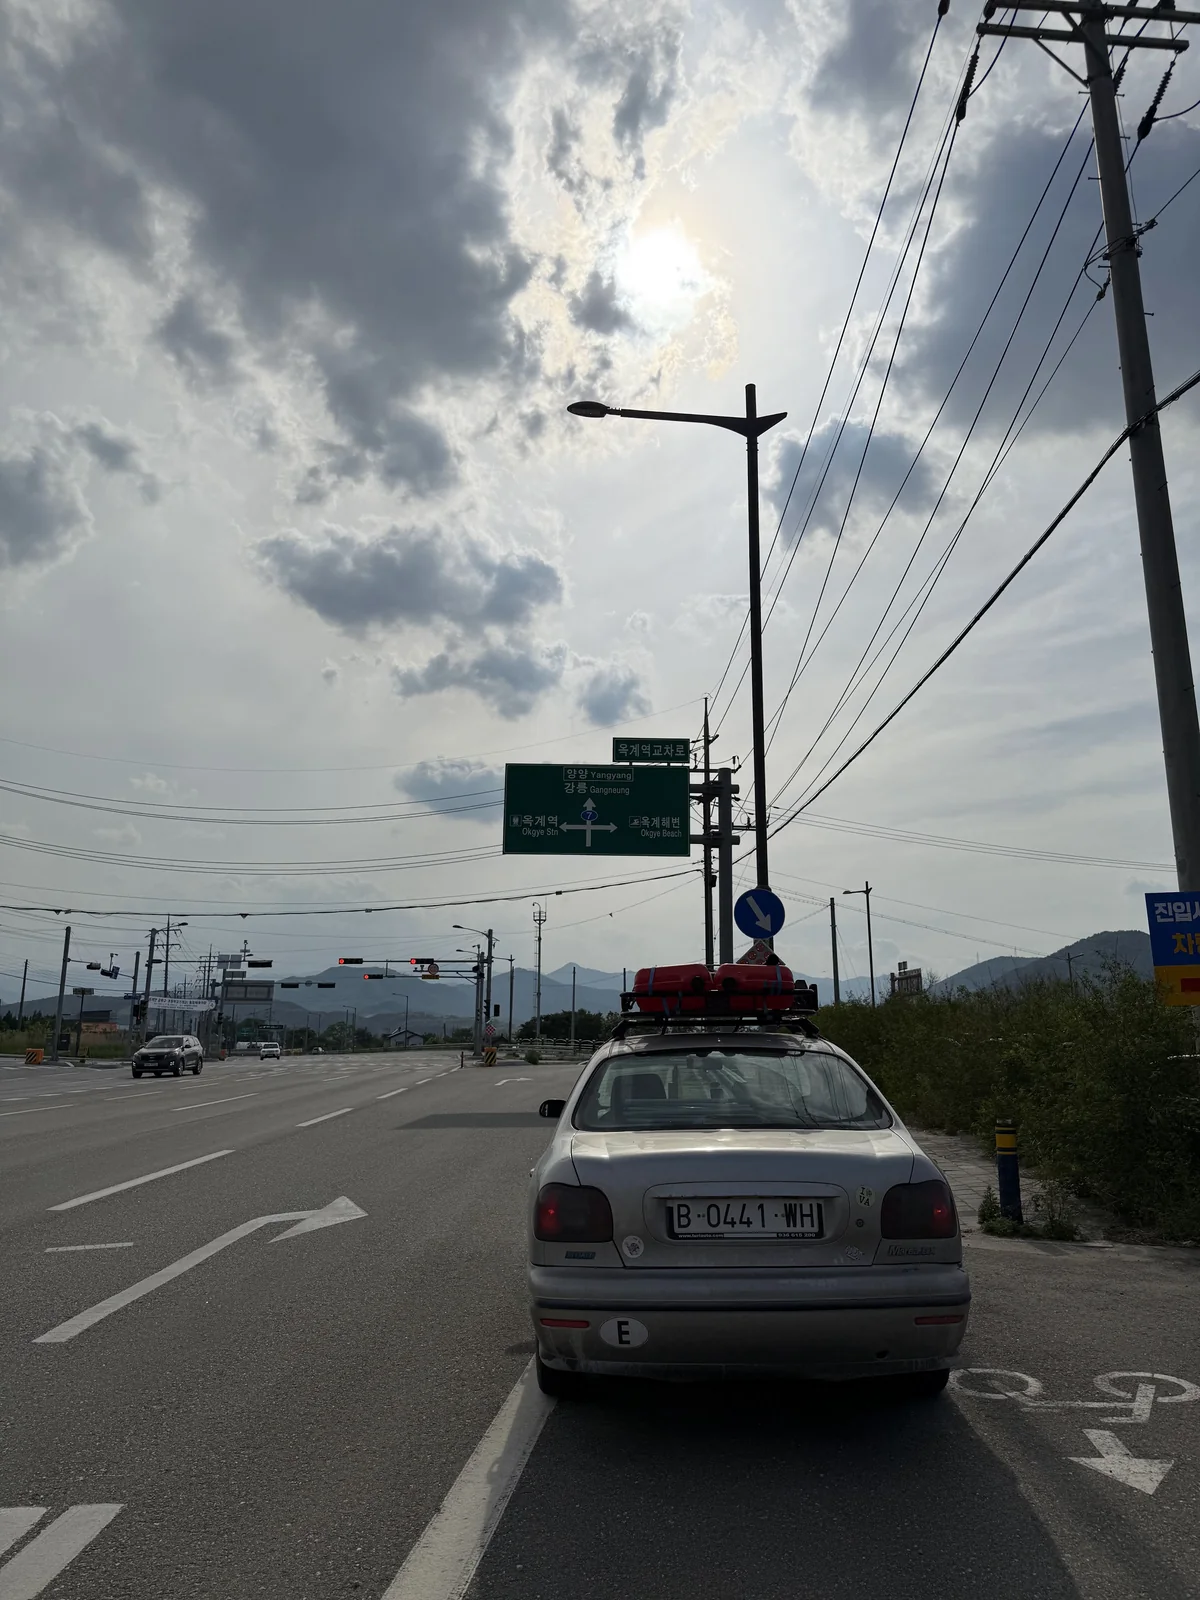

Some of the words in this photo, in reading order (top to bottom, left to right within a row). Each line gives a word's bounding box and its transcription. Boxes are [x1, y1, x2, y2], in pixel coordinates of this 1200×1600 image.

[618, 743, 686, 757] 옥계역교차로
[566, 768, 589, 779] 양양
[590, 771, 632, 780] Yangyang
[564, 782, 588, 794] 강릉
[589, 786, 630, 795] Gangneung
[522, 814, 558, 827] 옥계역
[586, 812, 593, 820] 7
[640, 816, 680, 829] 옥계해변
[522, 828, 545, 837] Okgye
[546, 828, 559, 836] Stn
[640, 829, 661, 839] Okgye
[662, 829, 682, 837] Beach
[617, 1320, 631, 1345] E
